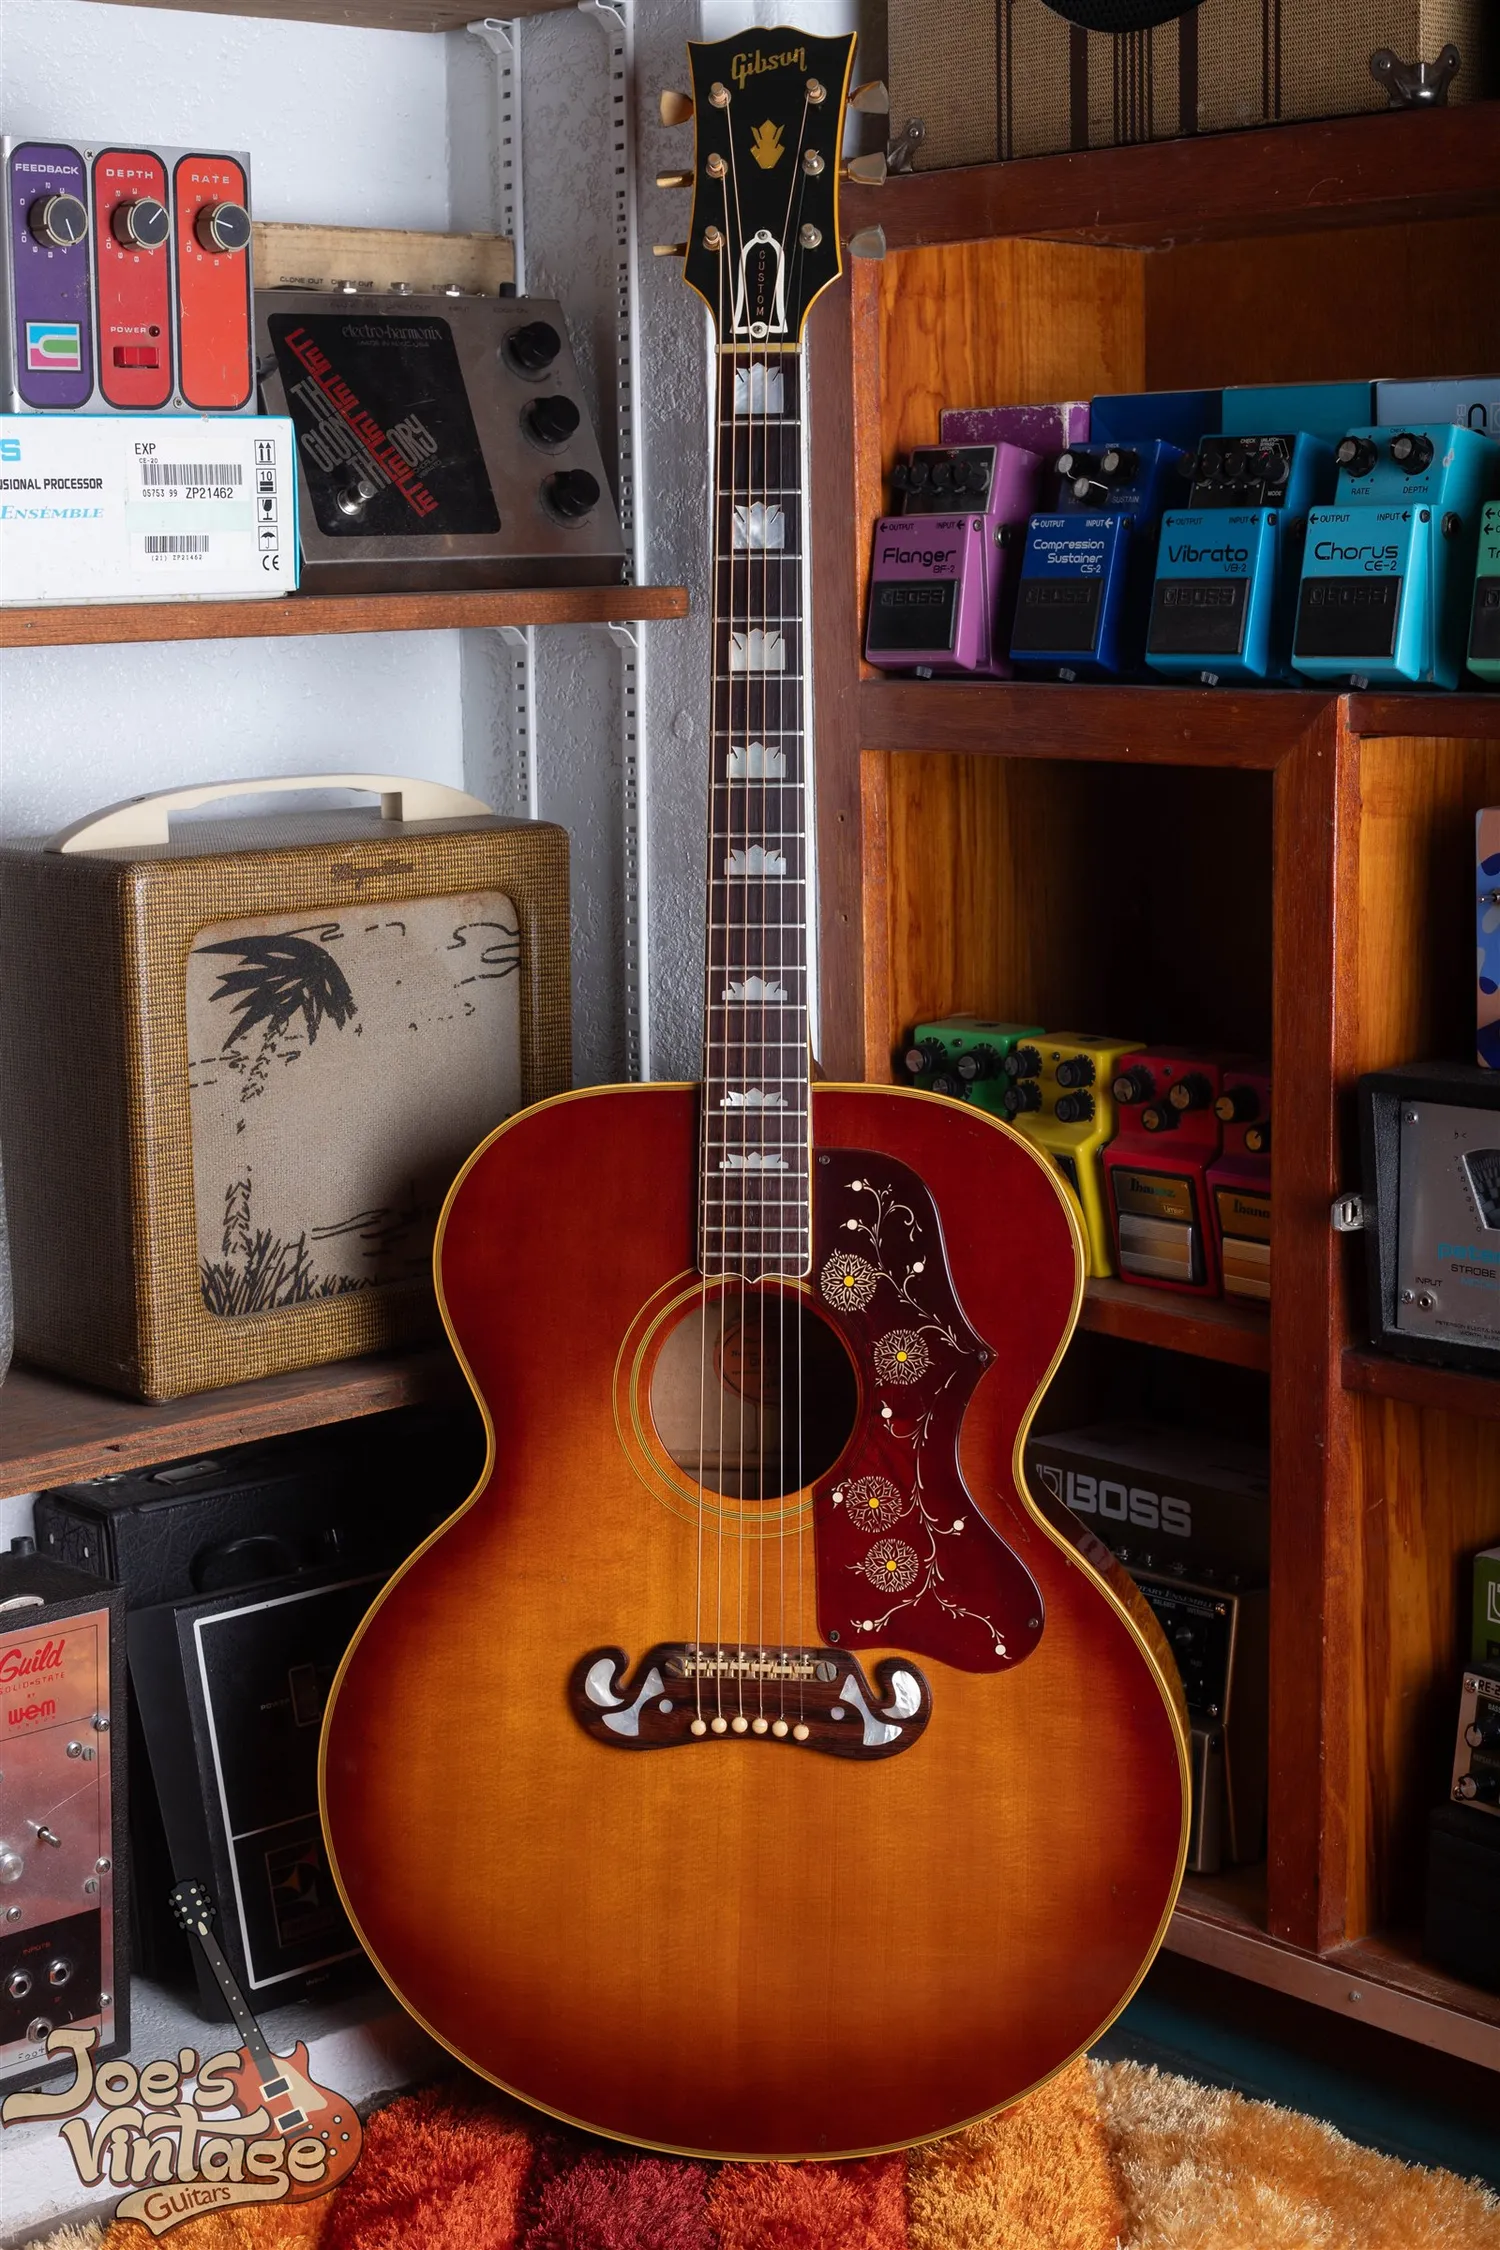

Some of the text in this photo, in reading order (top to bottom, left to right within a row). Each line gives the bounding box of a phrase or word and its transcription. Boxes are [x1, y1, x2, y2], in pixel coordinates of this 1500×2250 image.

[731, 46, 807, 90] Gibson
[15, 163, 79, 175] FEEDBACK
[106, 169, 154, 179] DEPTH
[191, 174, 230, 184] RATE
[755, 249, 766, 317] CUSTOM
[110, 326, 147, 334] POWER
[342, 323, 443, 341] electro-harmonix
[135, 443, 156, 455] EXP
[261, 471, 273, 481] 10
[44, 478, 103, 490] PROCESSOR
[1402, 485, 1428, 494] DEPTH
[142, 487, 233, 499] 05753 99 ZP21462
[1351, 487, 1370, 495] RATE
[1040, 519, 1105, 528] OUTPUT INPUT
[1175, 516, 1249, 526] OUTPUT INPUT
[1319, 513, 1400, 523] OUTPUT INPUT
[889, 521, 956, 531] OUTPUT INPUT
[1033, 538, 1105, 552] Compression
[1314, 541, 1399, 561] Chorus
[883, 547, 956, 567] Flanger
[1047, 552, 1103, 564] Sustainer
[1168, 544, 1249, 563] Vibrato
[933, 565, 955, 574] BF-2
[1080, 564, 1101, 573] CS-2
[1224, 563, 1247, 573] VB-2
[1364, 560, 1398, 572] CE-2
[1451, 1263, 1497, 1278] STROBE
[1415, 1276, 1443, 1287] INPUT
[1066, 1471, 1192, 1538] BOSS
[0, 1639, 66, 1683] Guild
